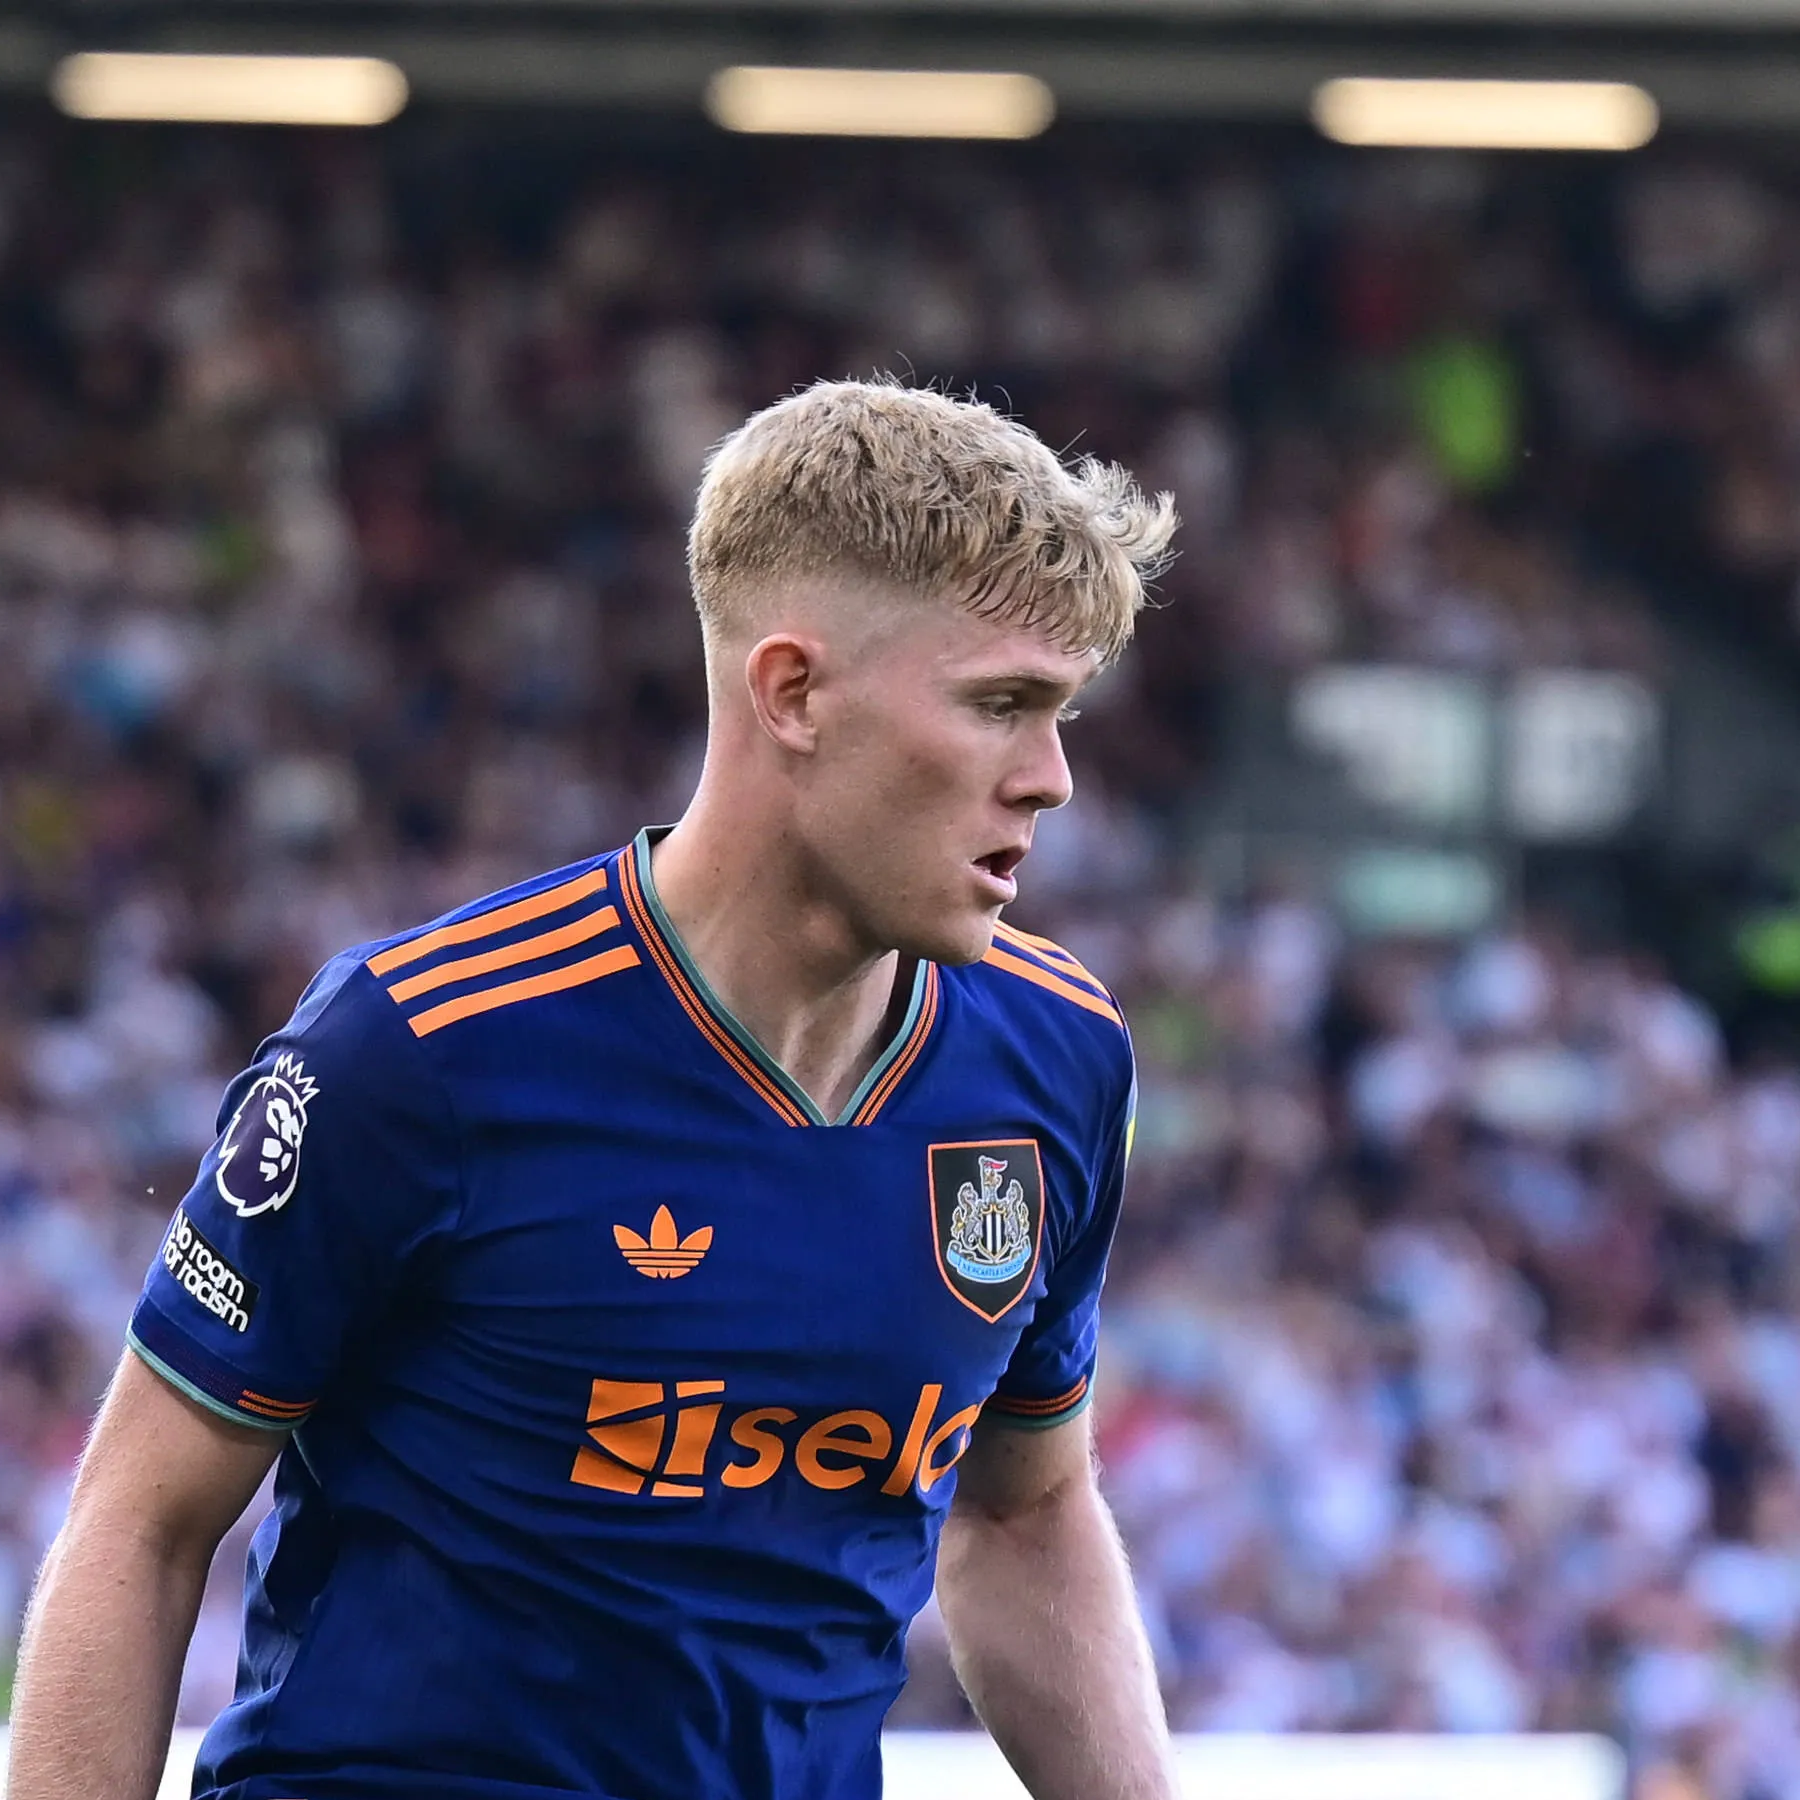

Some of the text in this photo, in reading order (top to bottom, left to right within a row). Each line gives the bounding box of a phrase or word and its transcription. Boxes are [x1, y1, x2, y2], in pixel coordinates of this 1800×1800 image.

[171, 1207, 244, 1304] No room
[177, 1260, 249, 1332] racism
